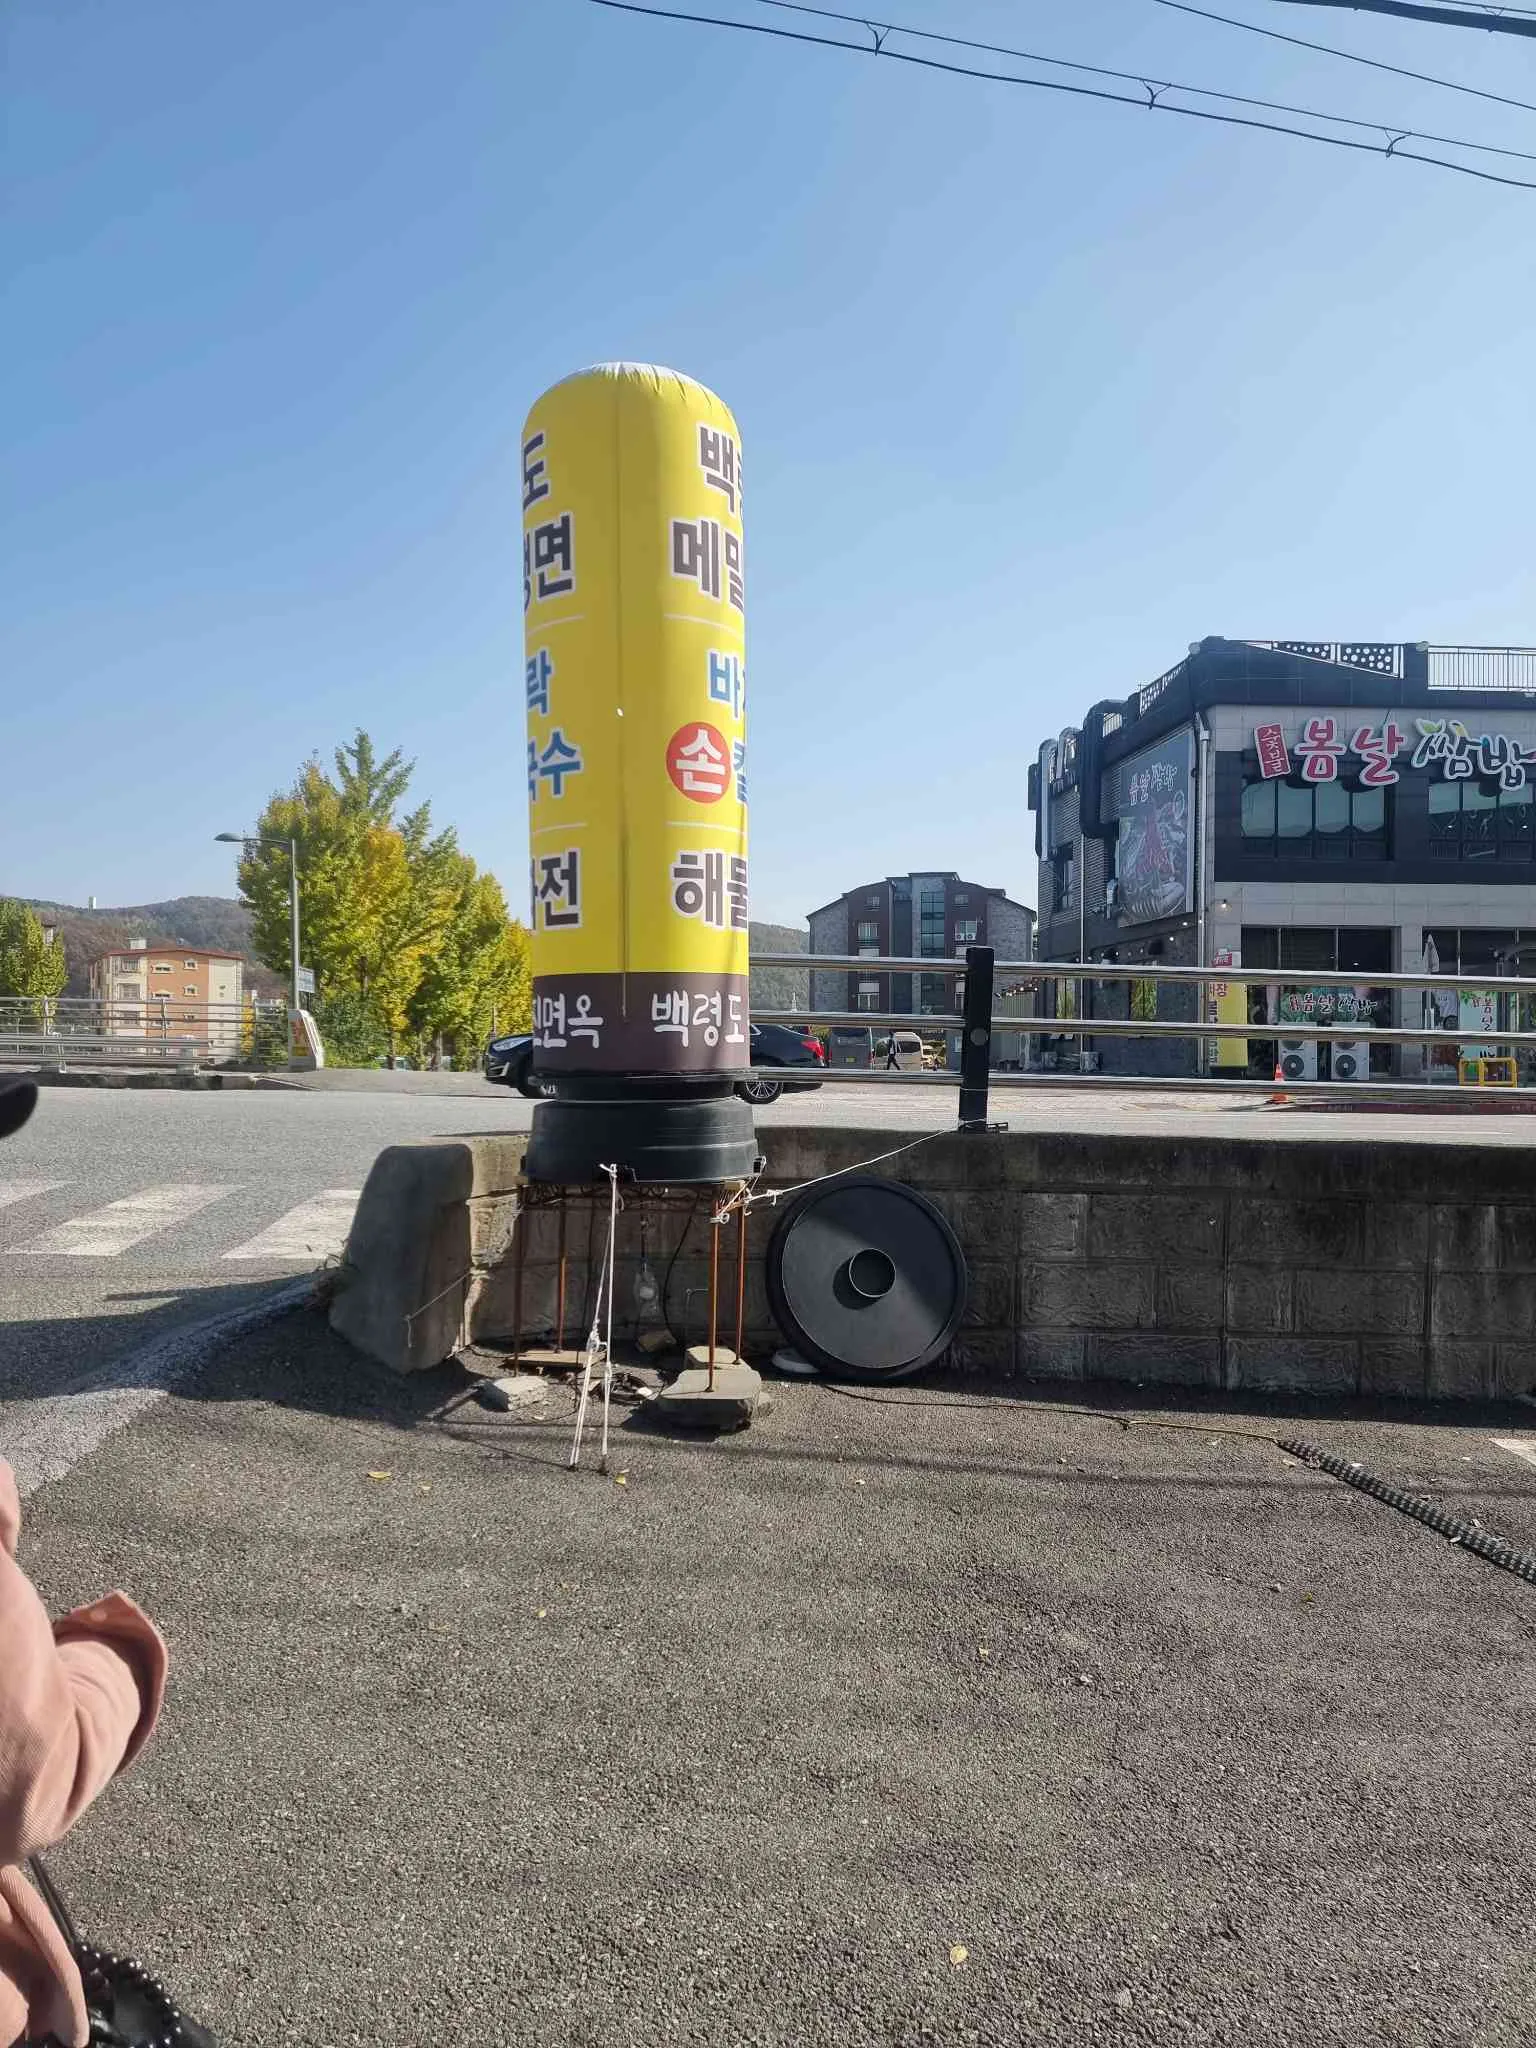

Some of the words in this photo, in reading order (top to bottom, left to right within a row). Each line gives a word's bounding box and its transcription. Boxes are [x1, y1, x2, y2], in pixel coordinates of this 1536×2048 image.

[698, 424, 743, 520] 백
[707, 649, 745, 719] 바
[532, 849, 581, 929] 전
[651, 990, 746, 1049] 백령도
